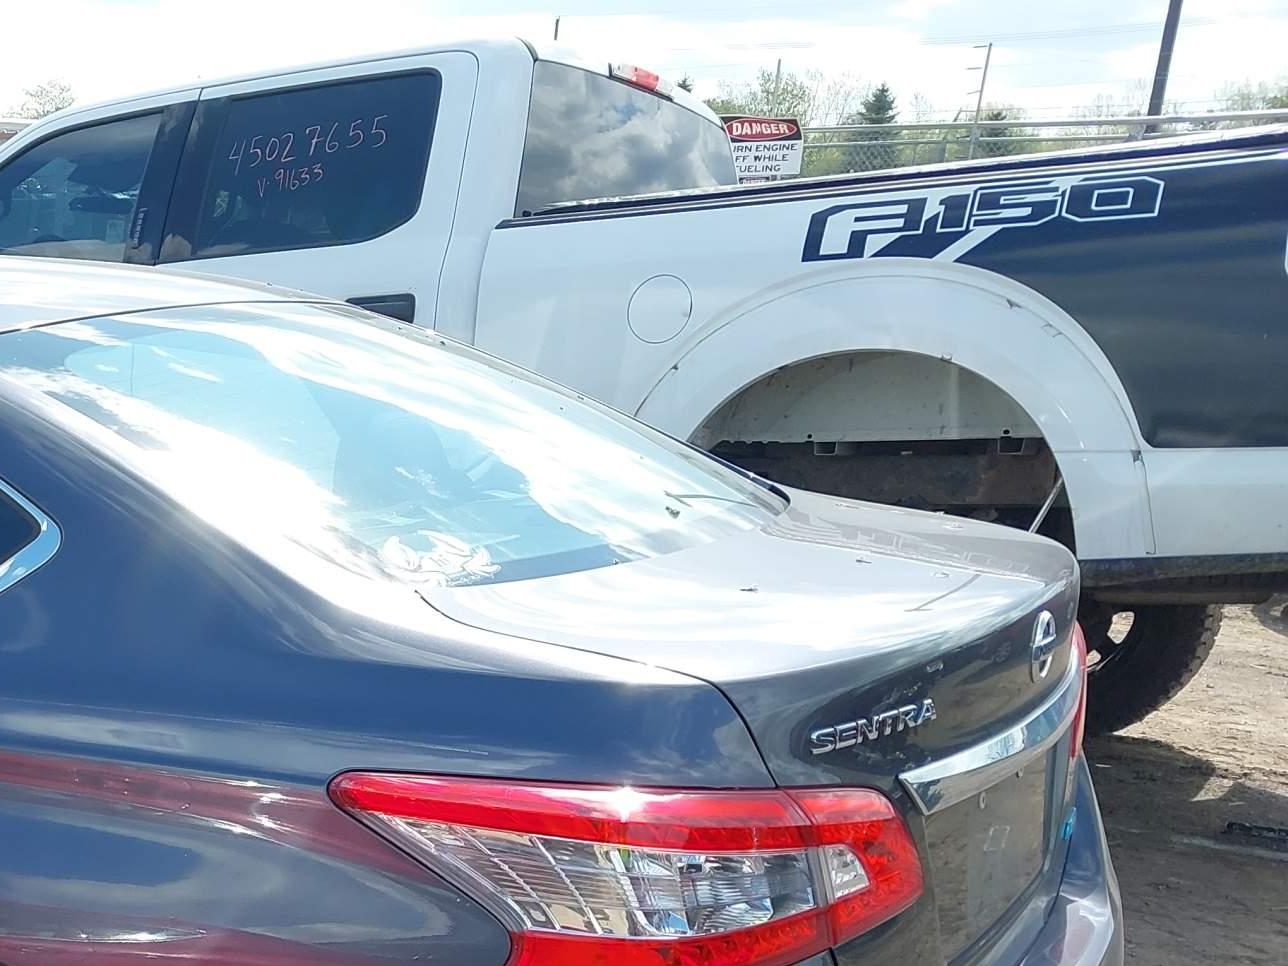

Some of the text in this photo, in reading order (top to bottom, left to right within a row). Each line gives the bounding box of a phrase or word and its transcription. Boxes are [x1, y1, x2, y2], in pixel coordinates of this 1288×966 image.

[732, 122, 789, 136] DANGER
[755, 143, 797, 152] ENGINE
[735, 153, 789, 163] FF WHILE
[810, 698, 938, 755] SENTRA
